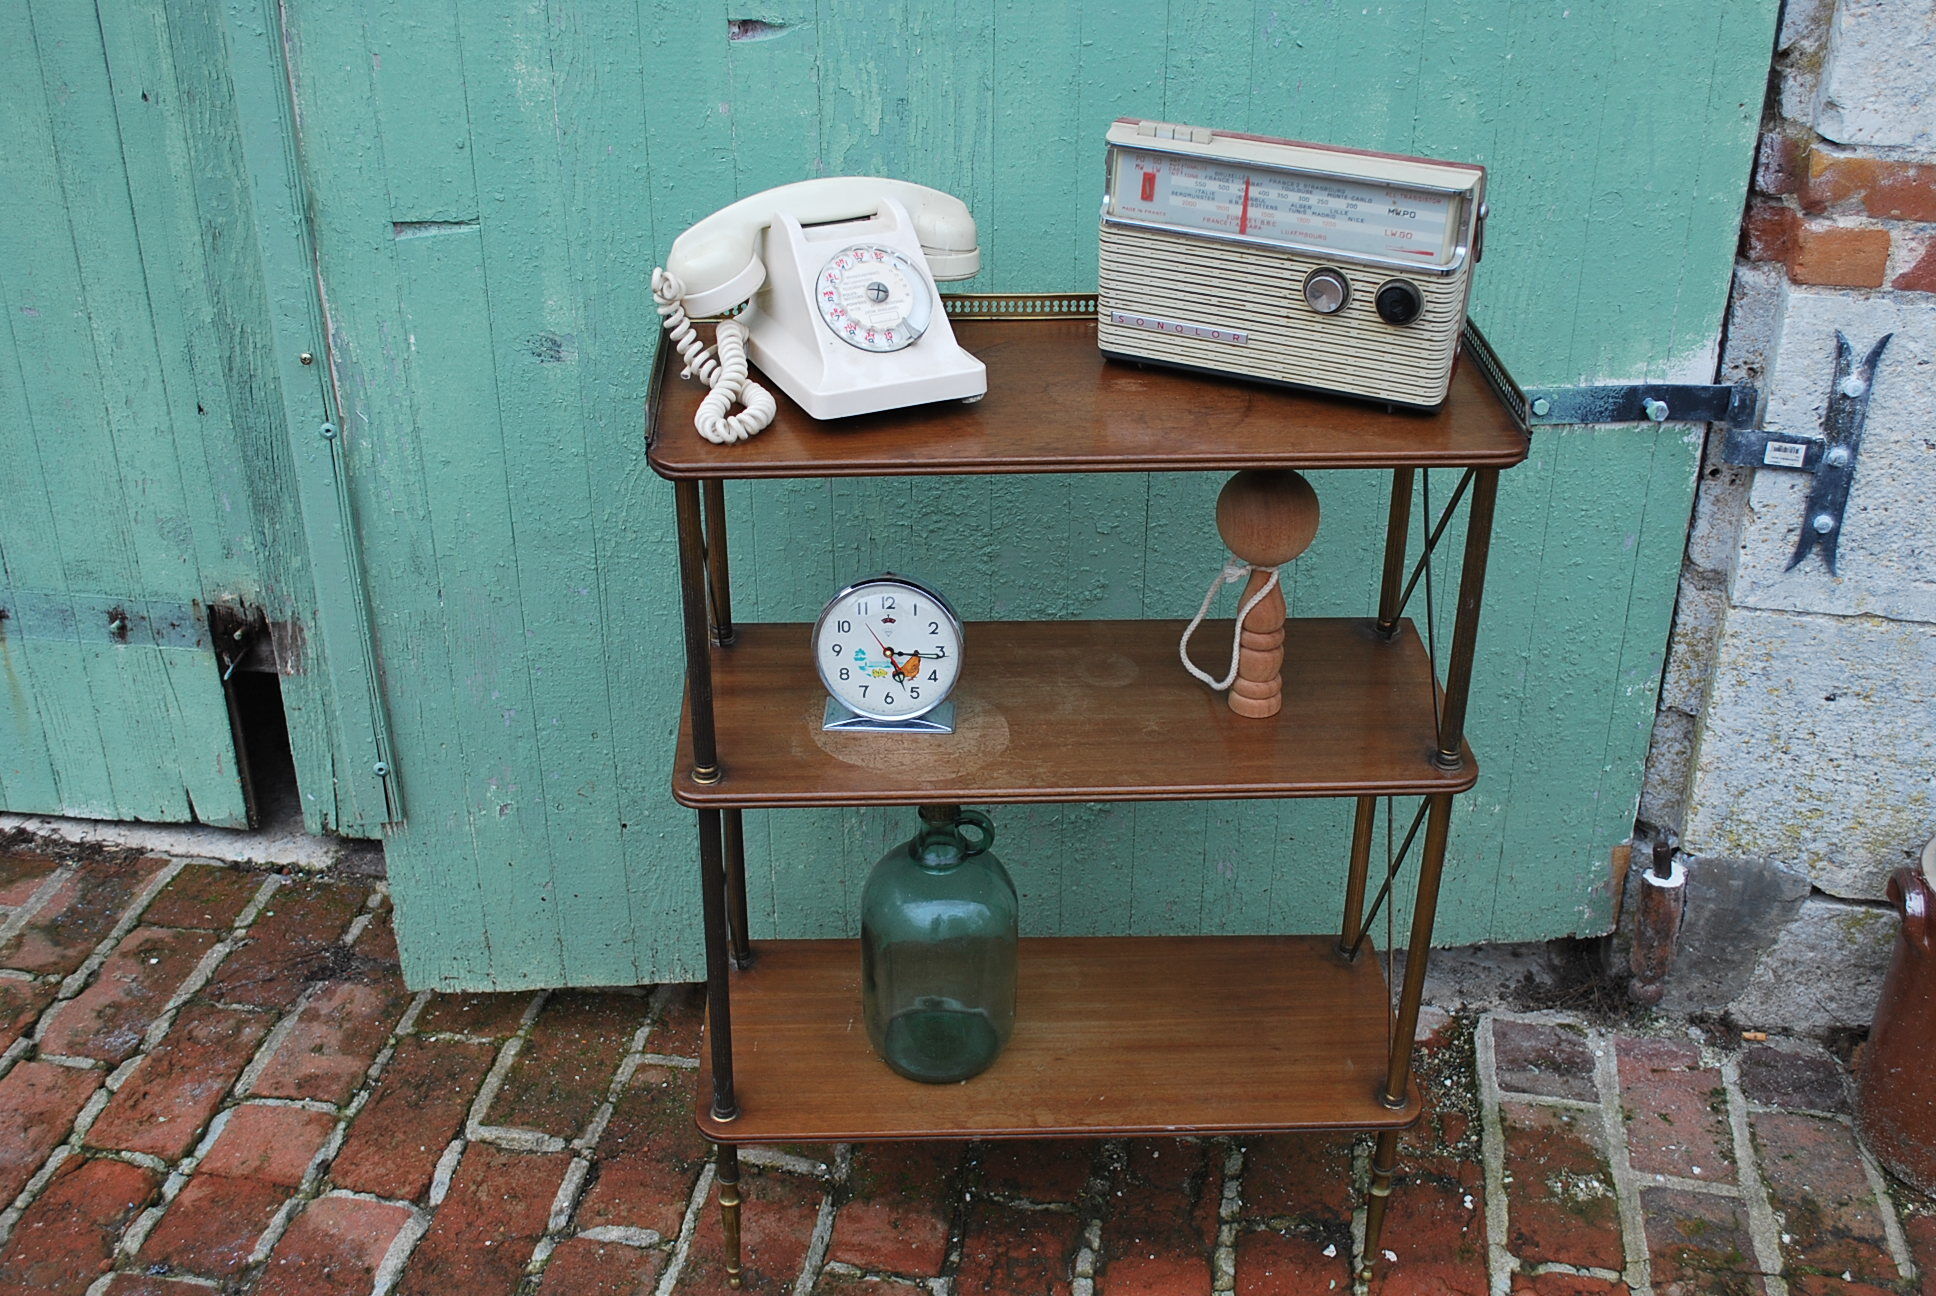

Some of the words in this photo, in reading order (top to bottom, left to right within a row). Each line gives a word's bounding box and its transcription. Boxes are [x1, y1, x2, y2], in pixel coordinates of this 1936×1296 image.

[1347, 216, 1366, 224] NICE
[1118, 315, 1240, 342] SONOLOR
[858, 602, 868, 615] 11
[882, 596, 896, 610] 12
[837, 620, 851, 633] 10
[928, 622, 939, 635] 2
[832, 644, 842, 656] 9
[936, 646, 945, 658] 3
[839, 668, 849, 680] 8
[928, 669, 938, 682] 4
[859, 685, 869, 698] 7
[910, 686, 920, 699] 5
[884, 692, 894, 705] 6
